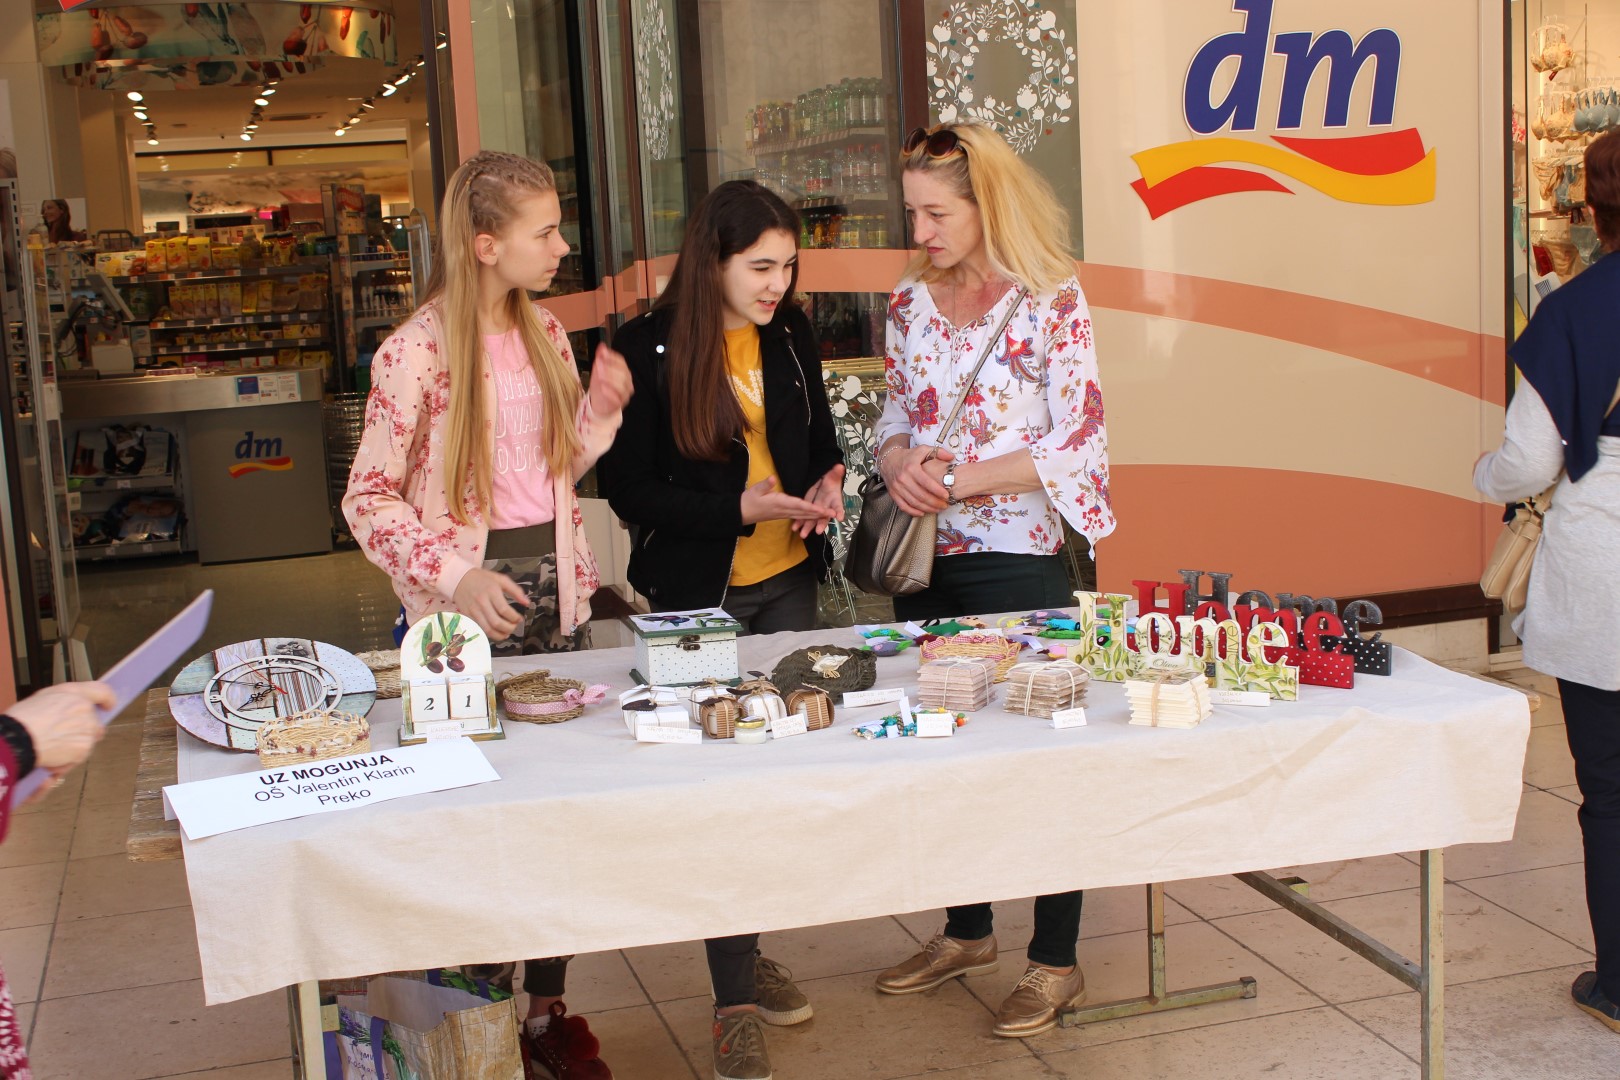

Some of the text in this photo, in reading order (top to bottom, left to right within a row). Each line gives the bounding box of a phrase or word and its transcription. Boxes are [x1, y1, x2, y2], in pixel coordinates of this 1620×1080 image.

[1183, 0, 1402, 136] dm
[235, 431, 283, 459] dm
[1070, 590, 1292, 672] Home
[424, 694, 472, 711] 2 1
[254, 765, 416, 802] OŠ Valentin Klarin
[259, 754, 394, 786] UZ MOGUNJA
[317, 788, 371, 806] Preko
